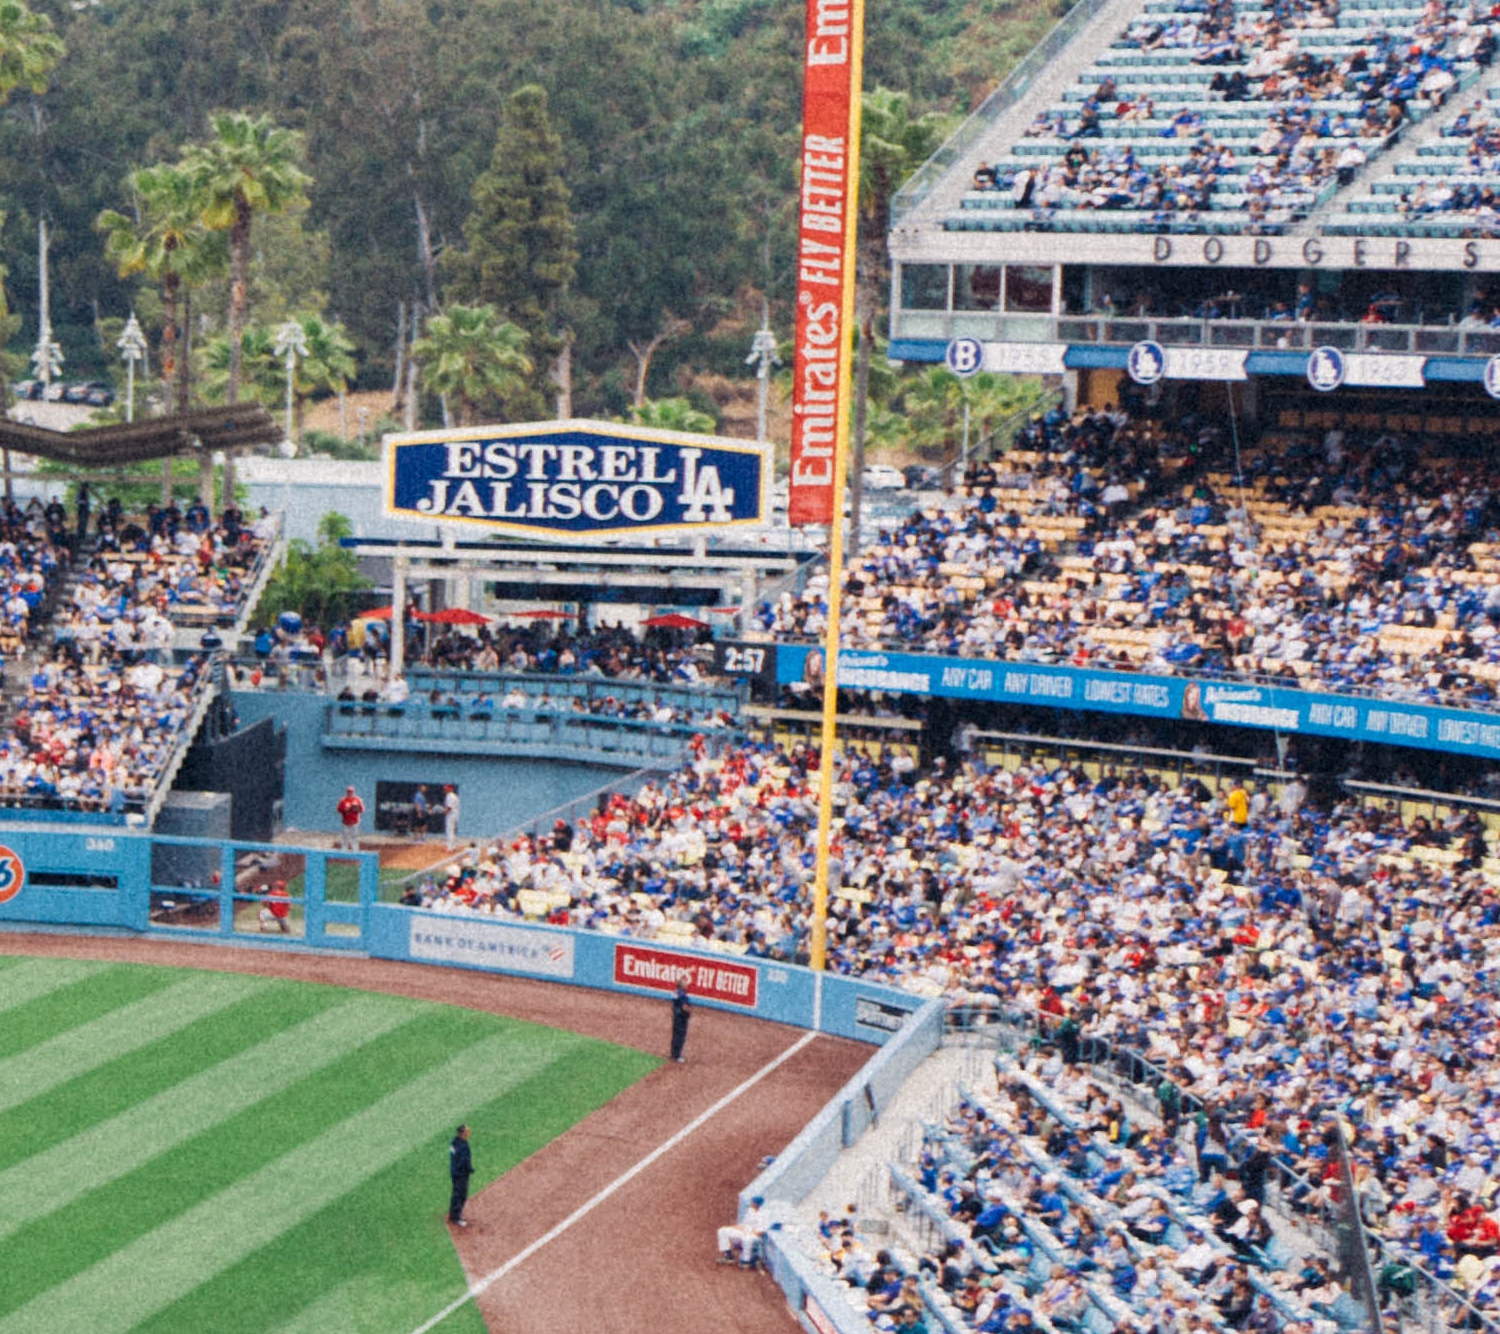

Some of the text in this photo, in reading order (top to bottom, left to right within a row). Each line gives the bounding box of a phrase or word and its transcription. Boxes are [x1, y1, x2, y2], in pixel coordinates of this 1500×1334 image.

[792, 133, 844, 487] Emirates FLY BETTER
[954, 341, 977, 370] B
[416, 480, 663, 521] JALISCO
[724, 648, 765, 673] 2:57
[623, 954, 693, 985] Emirates
[697, 967, 716, 989] FLY
[716, 970, 750, 996] BETTER
